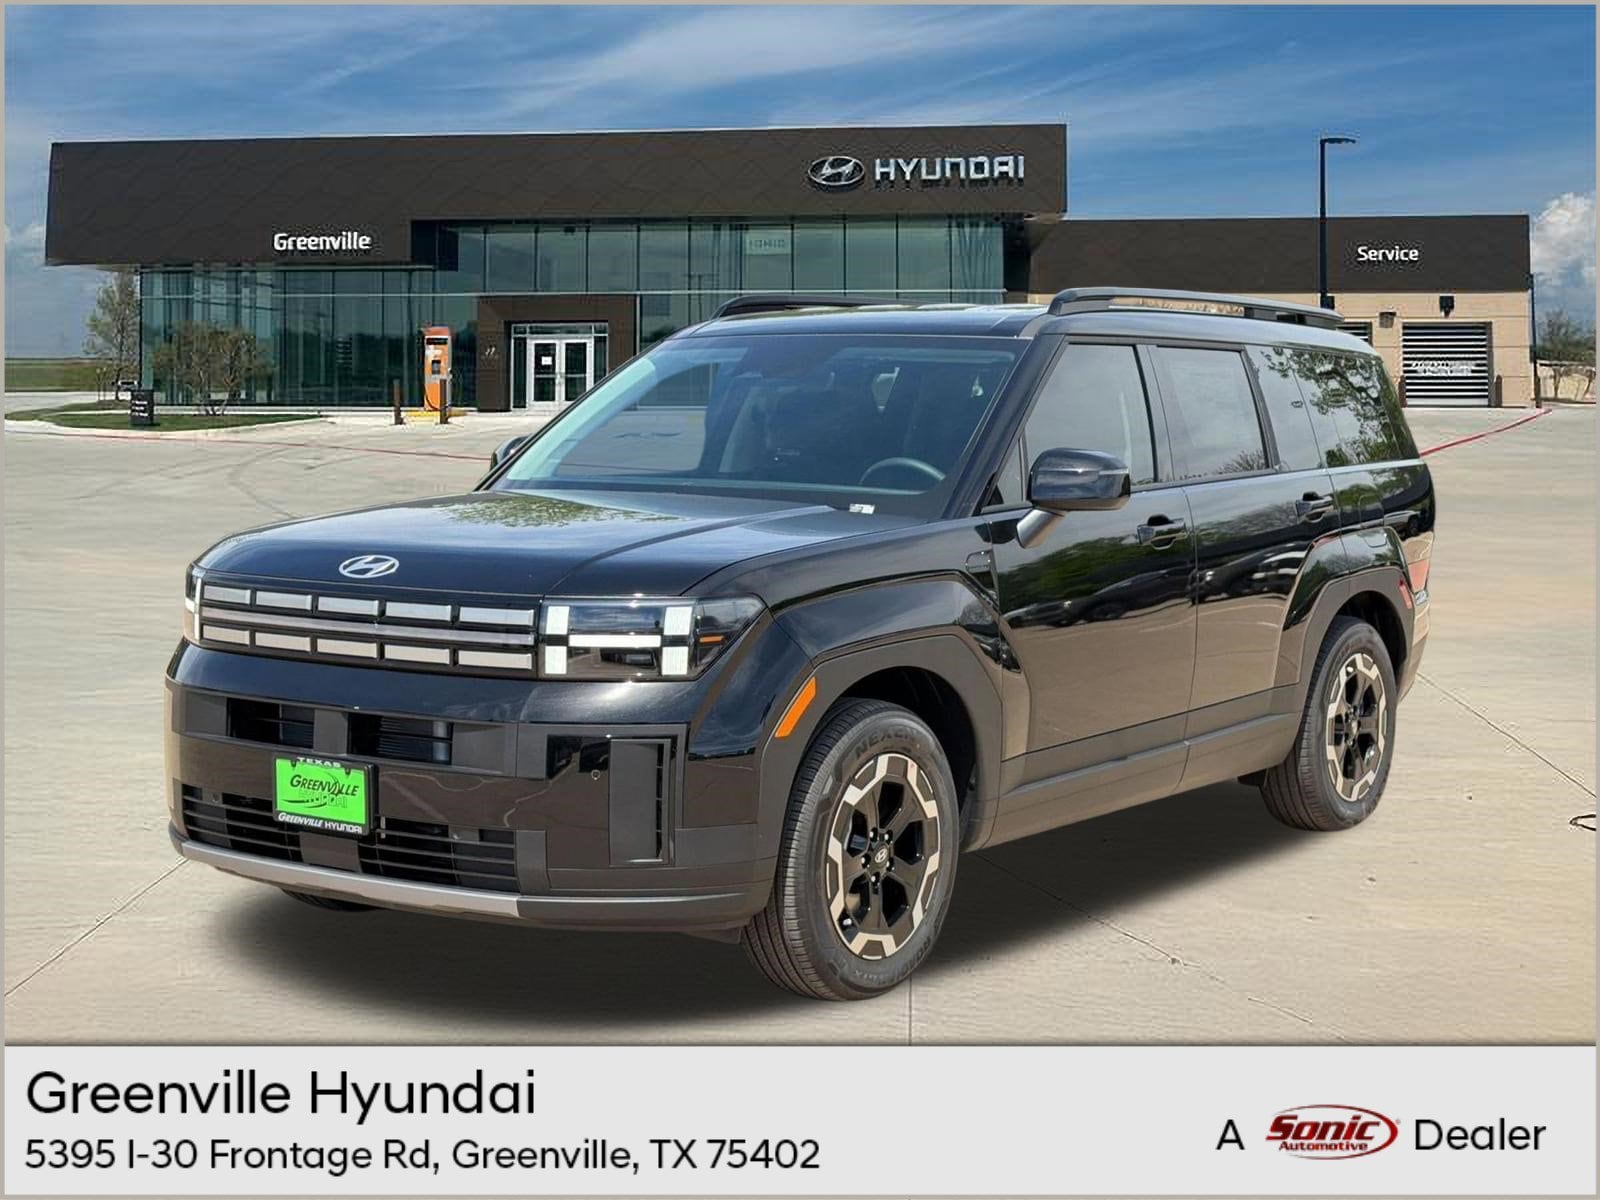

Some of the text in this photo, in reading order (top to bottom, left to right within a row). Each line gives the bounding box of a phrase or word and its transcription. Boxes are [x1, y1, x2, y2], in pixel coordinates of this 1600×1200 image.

[874, 154, 1025, 182] HYUNDAI
[273, 231, 372, 252] Greenville
[1357, 245, 1420, 261] Service
[290, 774, 359, 796] GREENVILLE
[278, 812, 362, 834] GREENVILLE HYUNDAI
